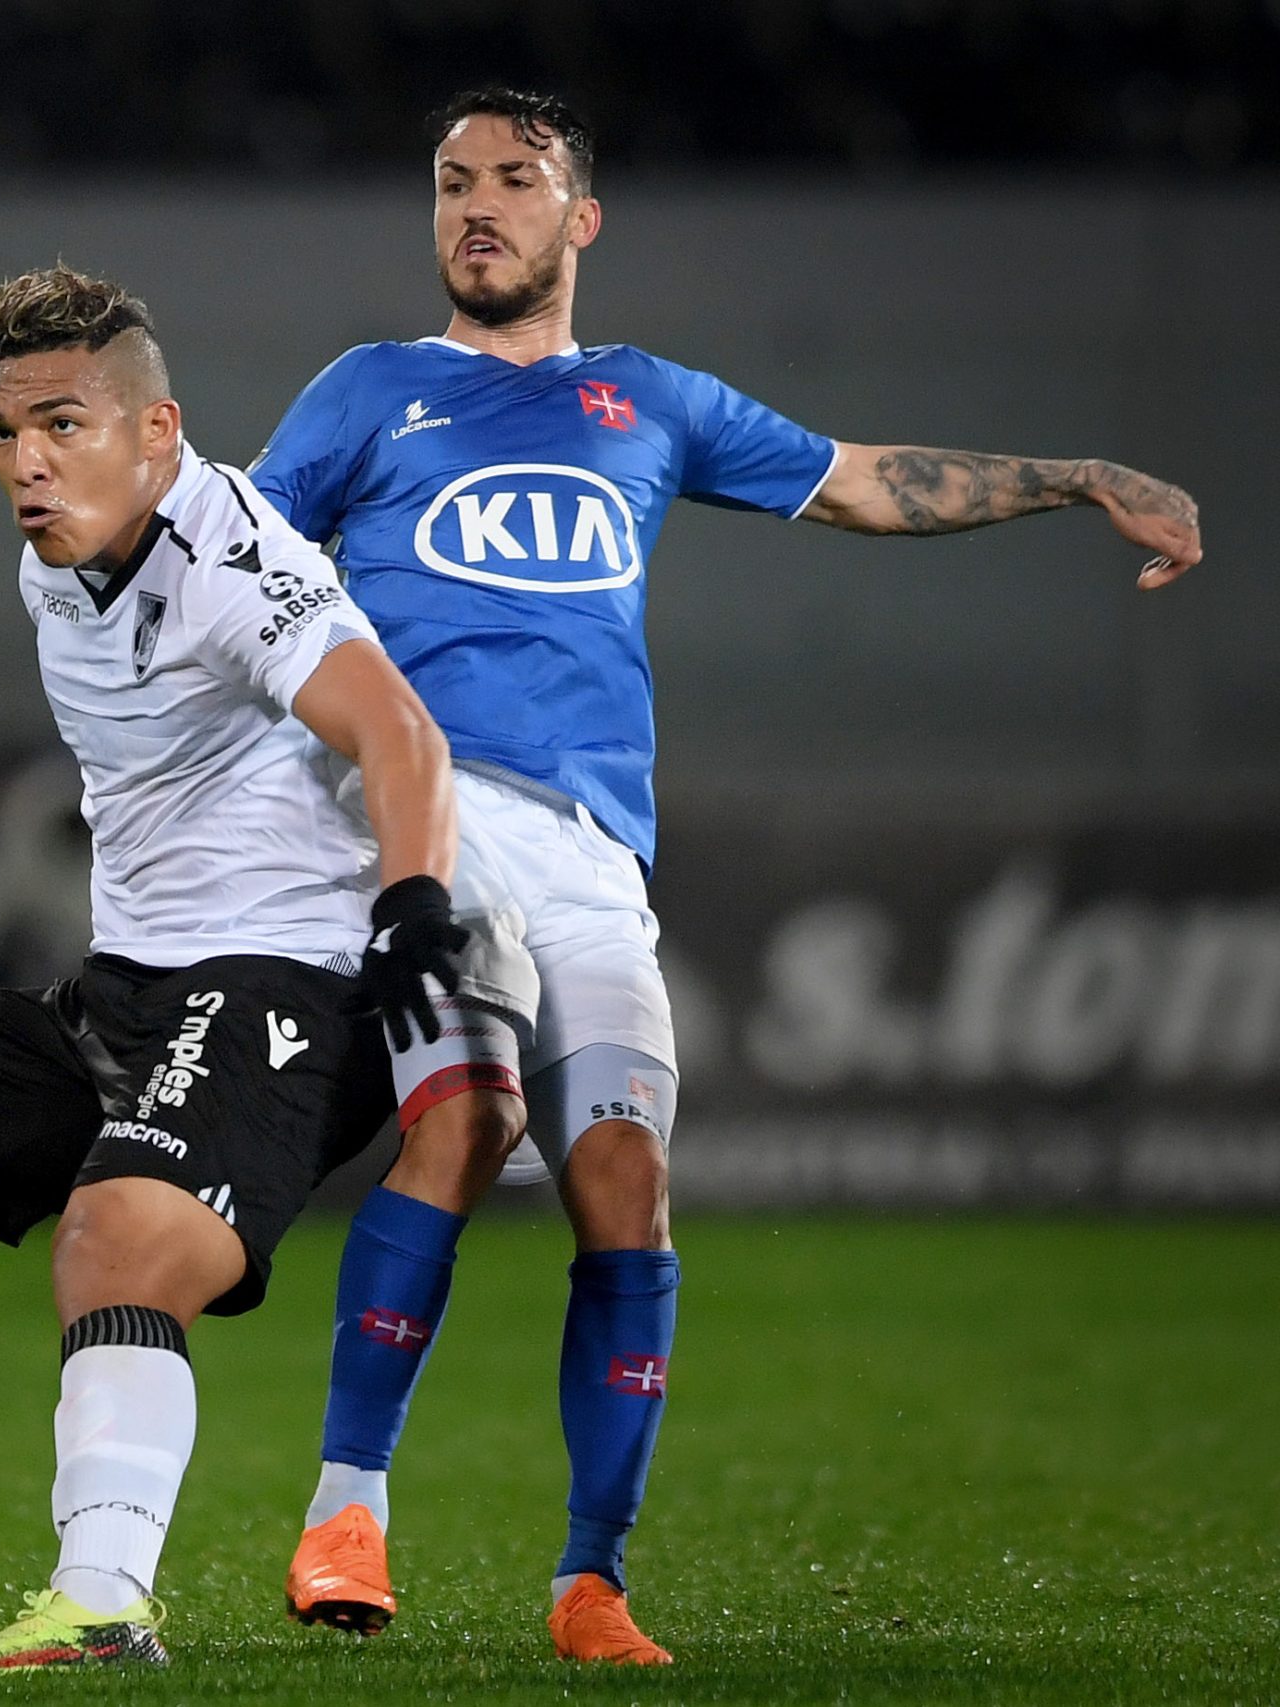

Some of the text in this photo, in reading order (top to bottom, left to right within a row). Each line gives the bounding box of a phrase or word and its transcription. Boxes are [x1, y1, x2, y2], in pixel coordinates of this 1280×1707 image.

[453, 492, 622, 572] KIA
[157, 990, 225, 1108] Smples
[99, 1121, 188, 1160] macron
